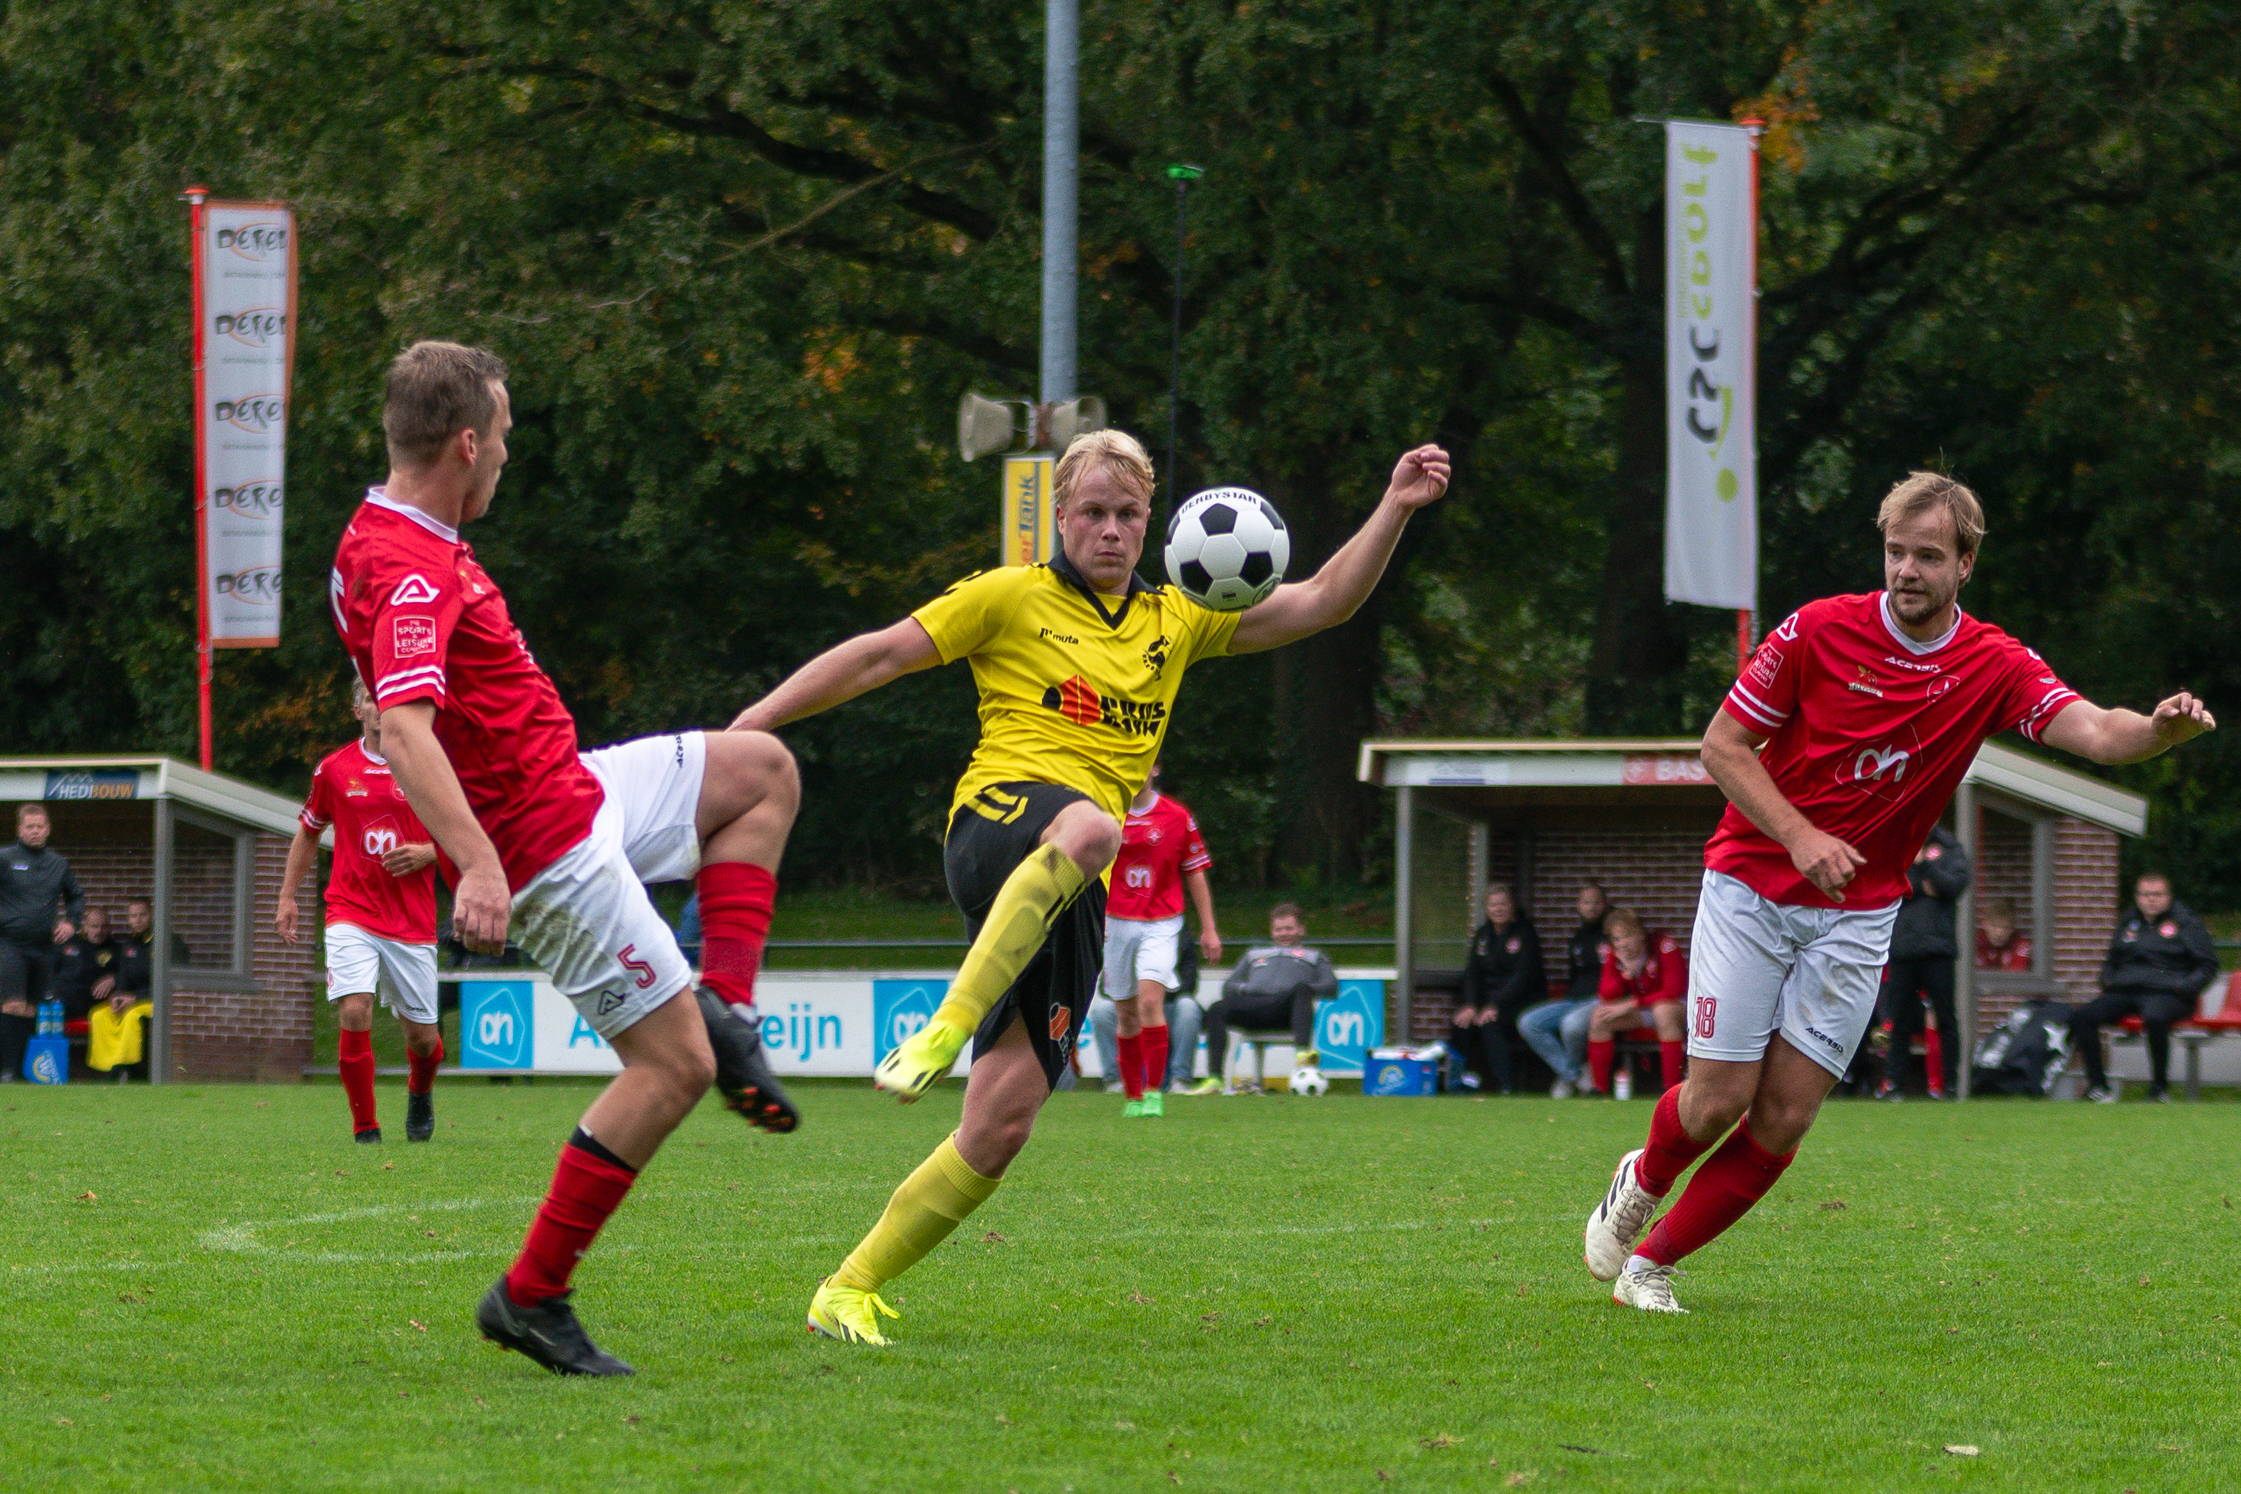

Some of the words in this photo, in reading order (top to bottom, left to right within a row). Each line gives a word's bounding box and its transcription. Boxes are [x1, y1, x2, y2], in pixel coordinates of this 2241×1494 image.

[397, 626, 433, 636] SPORTS
[58, 784, 135, 799] HEDIBOUW
[617, 943, 656, 989] 5
[1694, 997, 1717, 1039] 18
[1805, 1027, 1844, 1054] ACERBIS
